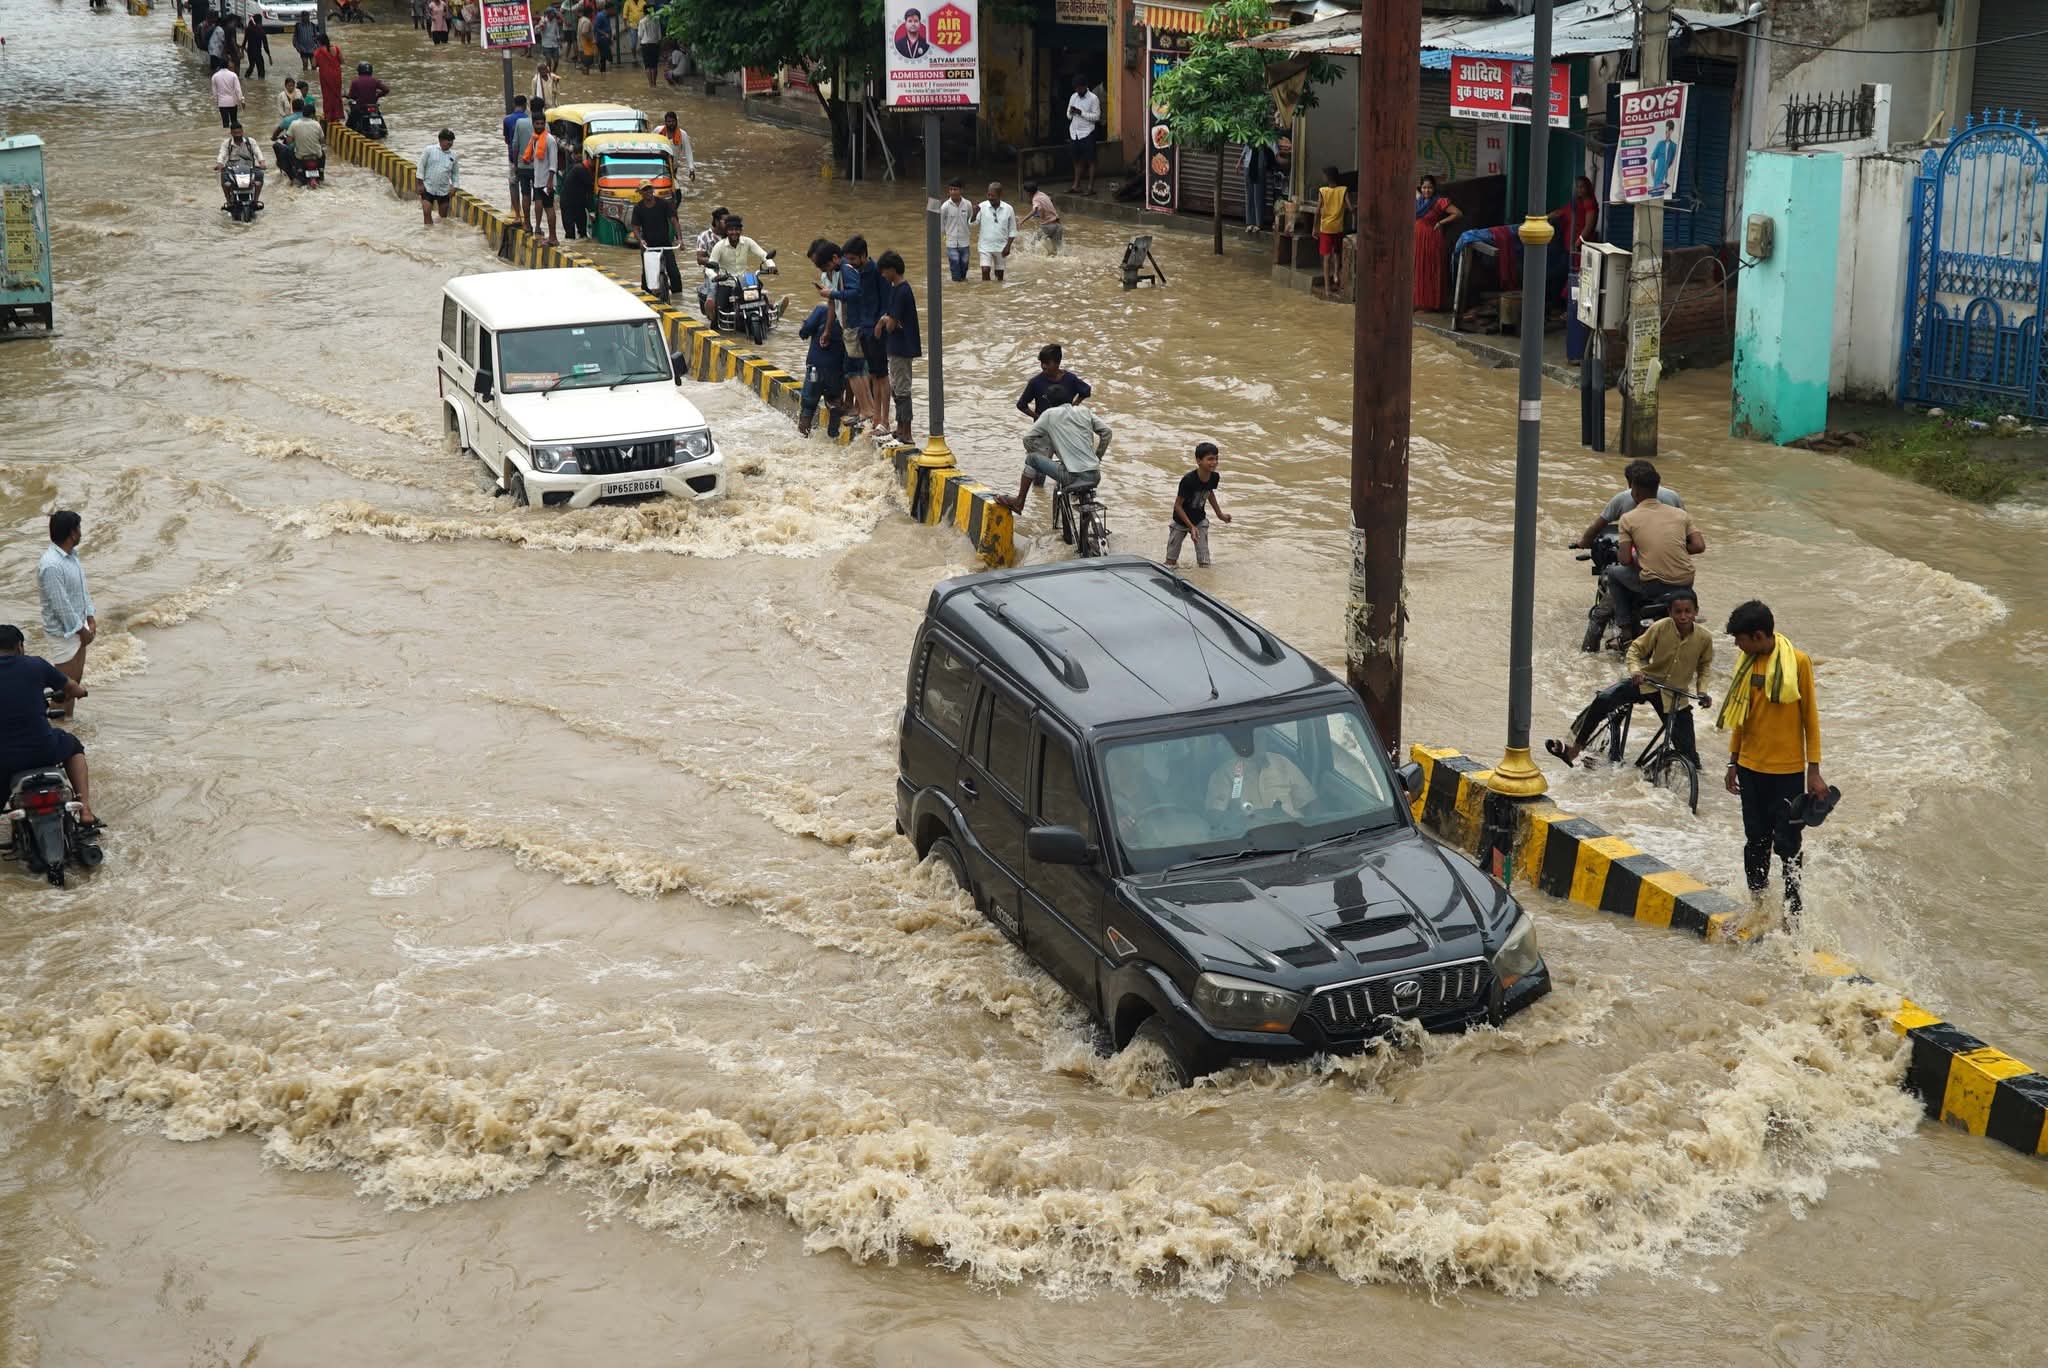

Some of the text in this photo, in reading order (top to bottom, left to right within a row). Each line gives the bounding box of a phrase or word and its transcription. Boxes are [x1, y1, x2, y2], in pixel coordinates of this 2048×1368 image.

[937, 17, 961, 31] AIR
[937, 31, 962, 45] 272
[892, 70, 973, 79] ADMISSIONS OPEN
[1460, 61, 1502, 83] आदित्य
[1457, 85, 1473, 102] बुक
[1625, 89, 1680, 114] BOYS
[607, 480, 660, 495] UP65ER0664
